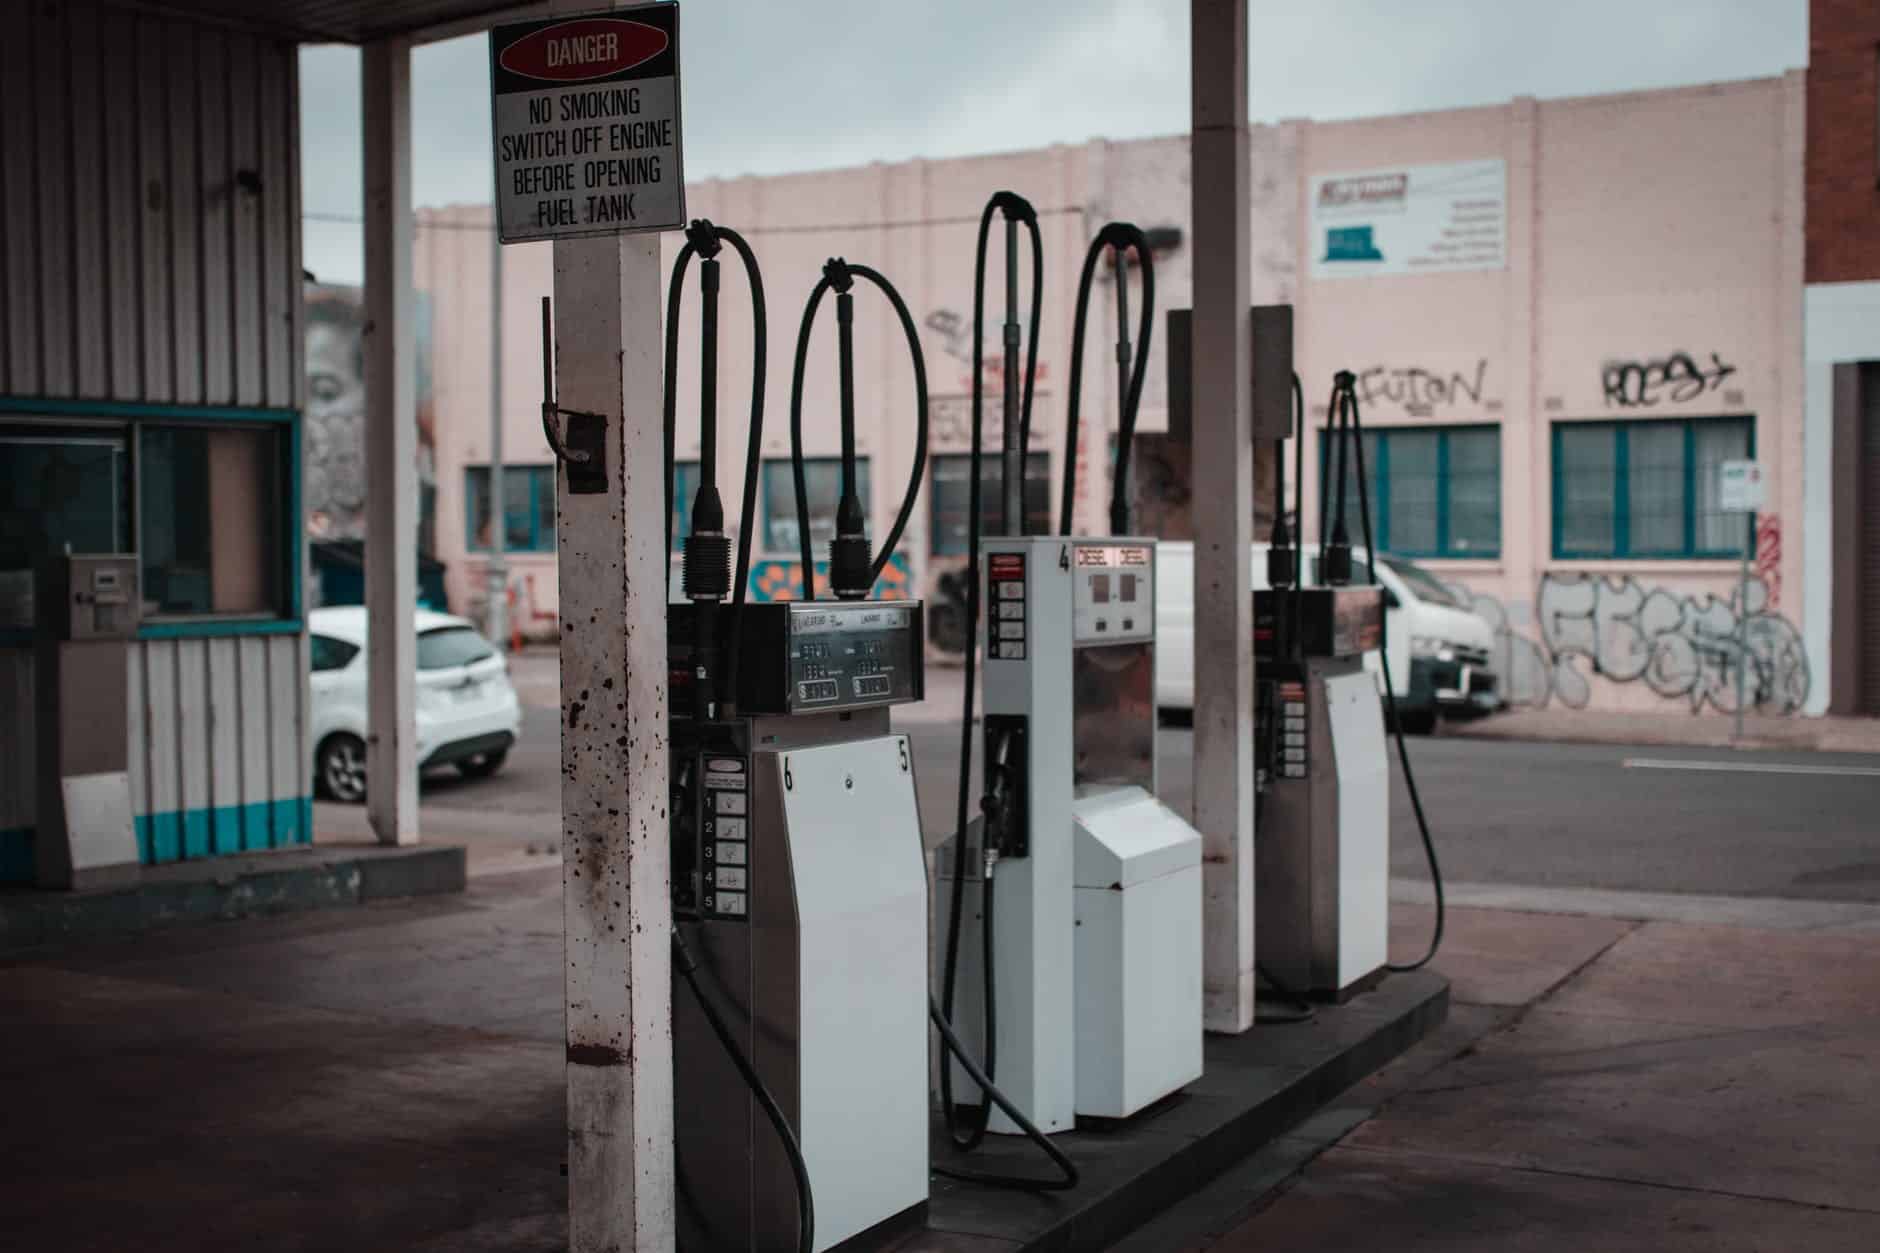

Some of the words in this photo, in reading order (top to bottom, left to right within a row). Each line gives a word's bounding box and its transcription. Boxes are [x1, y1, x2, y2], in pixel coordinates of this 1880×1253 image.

[547, 32, 619, 67] DANGER
[529, 96, 552, 125] NO
[560, 87, 641, 121] SMOKING
[502, 130, 566, 162] SWITCH
[572, 126, 603, 154] OFF
[610, 119, 672, 152] ENGINE
[513, 163, 575, 196] BEFORE
[584, 156, 661, 189] OPENING
[538, 199, 578, 228] FUEL
[586, 193, 636, 224] TANK
[1059, 543, 1069, 572] 4
[898, 739, 908, 772] 5
[783, 756, 793, 791] 6
[705, 822, 713, 833] 2
[705, 846, 713, 858] 3
[705, 871, 713, 883] 4
[705, 896, 713, 907] 5
